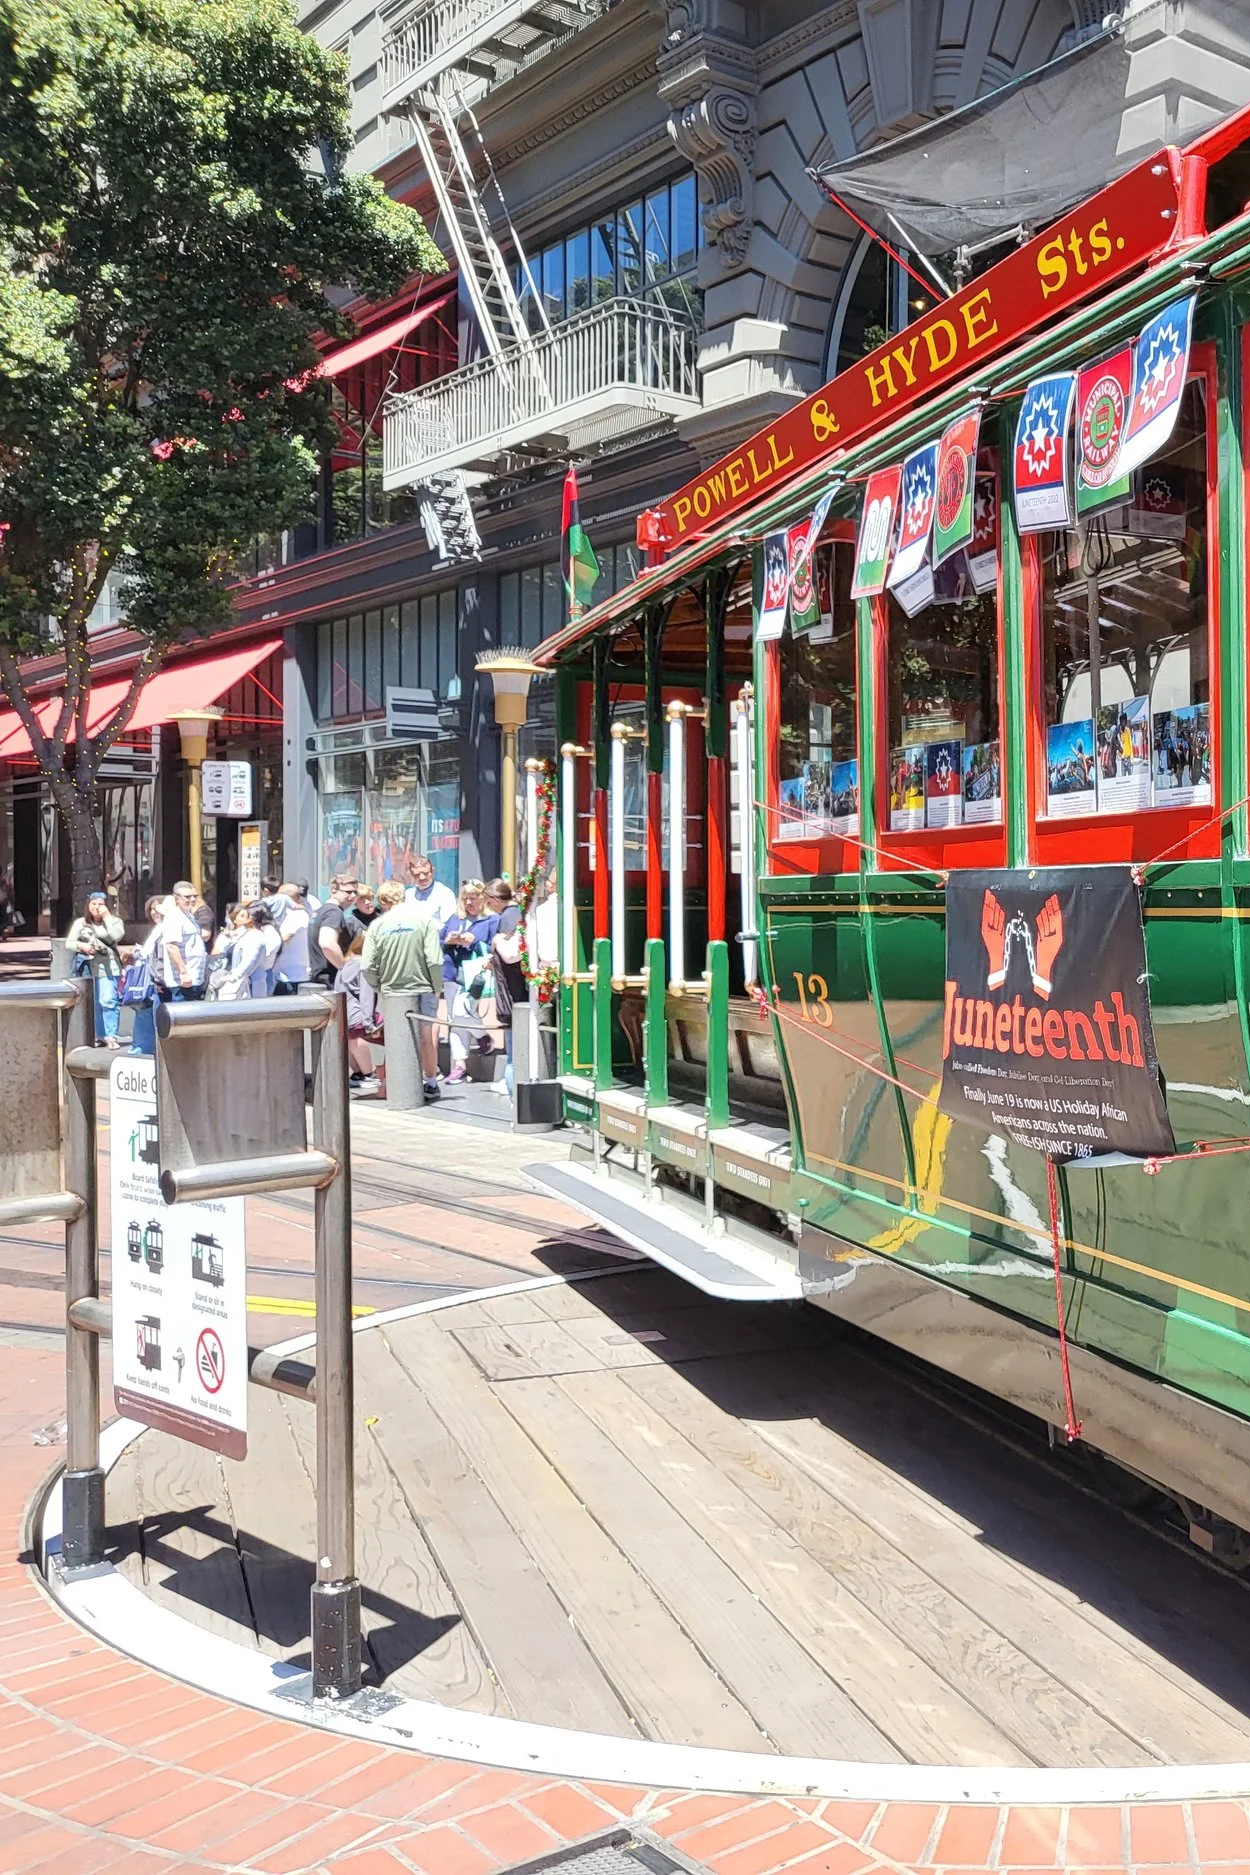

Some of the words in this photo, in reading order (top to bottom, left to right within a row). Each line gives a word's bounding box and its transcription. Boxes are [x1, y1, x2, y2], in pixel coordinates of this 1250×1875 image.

[673, 437, 795, 534] POWELL
[810, 398, 840, 442] &
[864, 287, 999, 407] HYDE
[1036, 217, 1126, 298] Sts.
[1085, 381, 1121, 421] MUNICIPAL
[1083, 424, 1118, 462] RAILWAY
[792, 972, 833, 1027] 13
[943, 981, 1144, 1069] Juneteenth
[116, 1070, 148, 1094] Cable
[964, 1086, 986, 1106] Finally
[987, 1090, 1004, 1105] June
[1005, 1093, 1014, 1107] 19
[1015, 1094, 1023, 1108] is
[1024, 1098, 1043, 1110] now
[1044, 1101, 1049, 1111] a
[1049, 1098, 1063, 1113] US
[1062, 1100, 1099, 1120] Holiday
[1101, 1102, 1128, 1122] African
[992, 1111, 1032, 1130] Americans
[1033, 1119, 1058, 1134] across
[1058, 1121, 1075, 1135] the
[1076, 1125, 1108, 1140] nation.
[1074, 1142, 1094, 1158] 1865
[138, 1377, 151, 1388] hands
[191, 1394, 197, 1403] No
[209, 1401, 218, 1412] and
